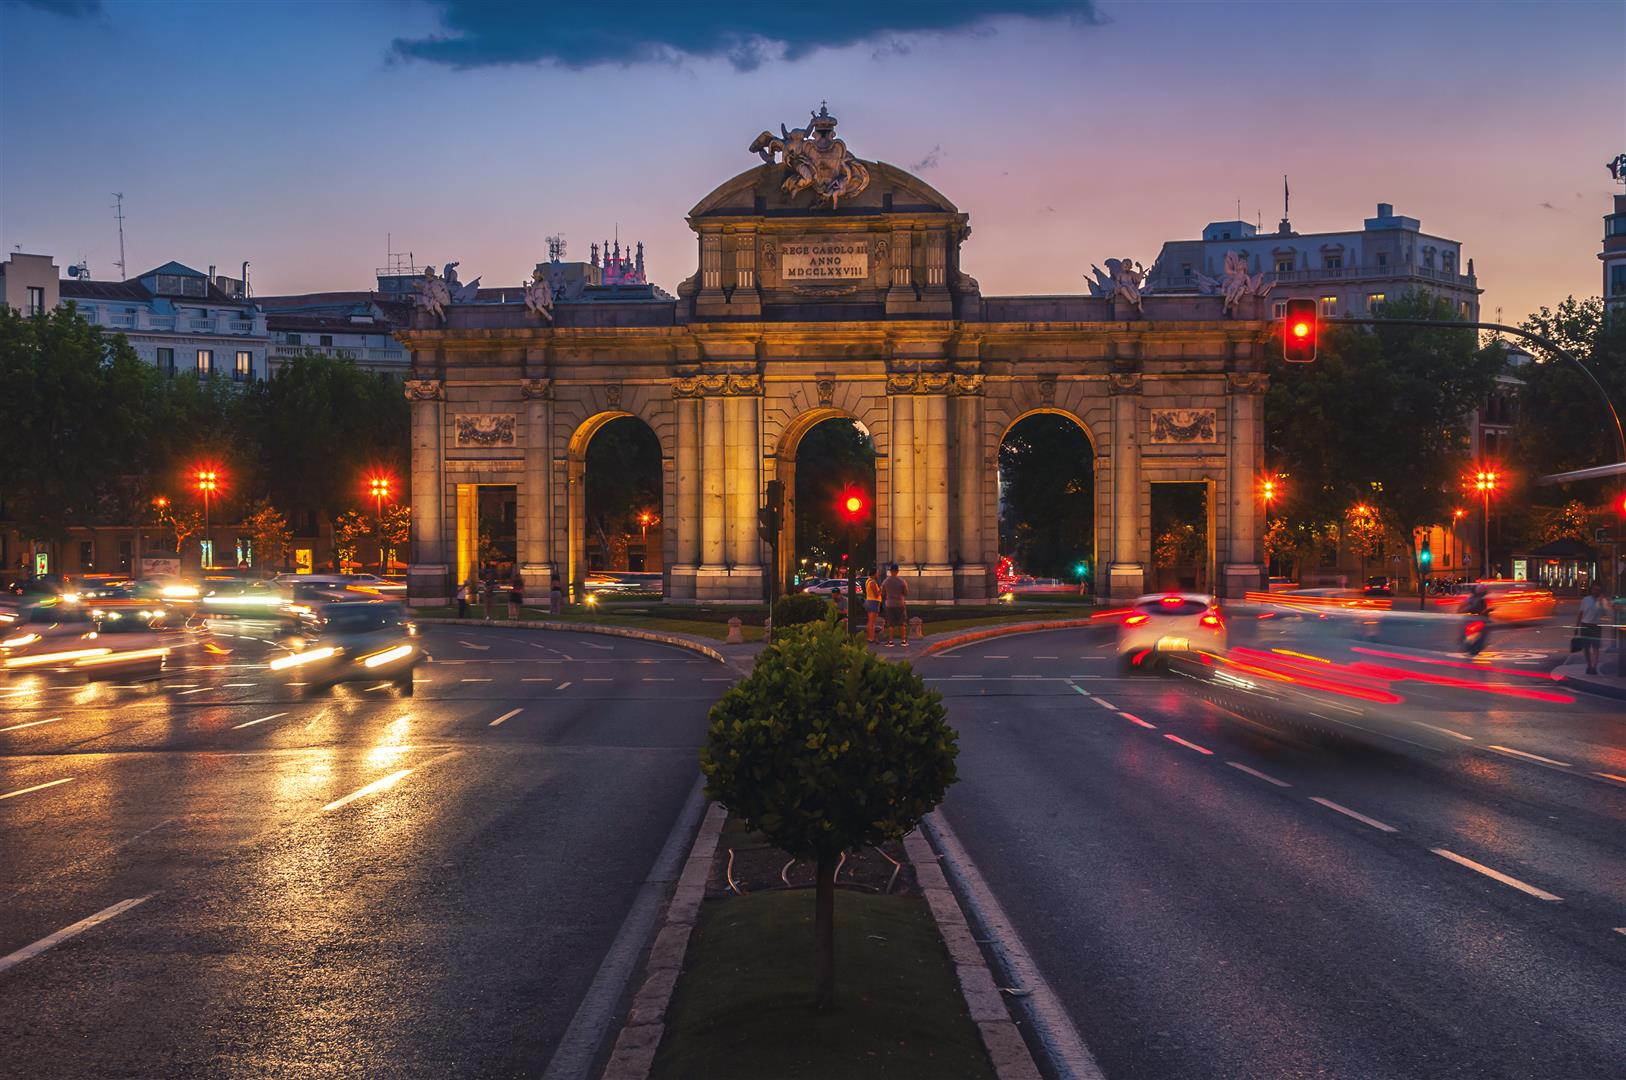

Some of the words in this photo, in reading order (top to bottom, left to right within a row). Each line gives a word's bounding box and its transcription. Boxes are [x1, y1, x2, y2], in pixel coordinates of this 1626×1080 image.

[783, 246, 809, 255] REGE
[812, 246, 854, 255] CAROLO
[856, 246, 868, 254] III
[810, 257, 841, 266] ANNO
[788, 267, 863, 276] MDCCLXXVIII
